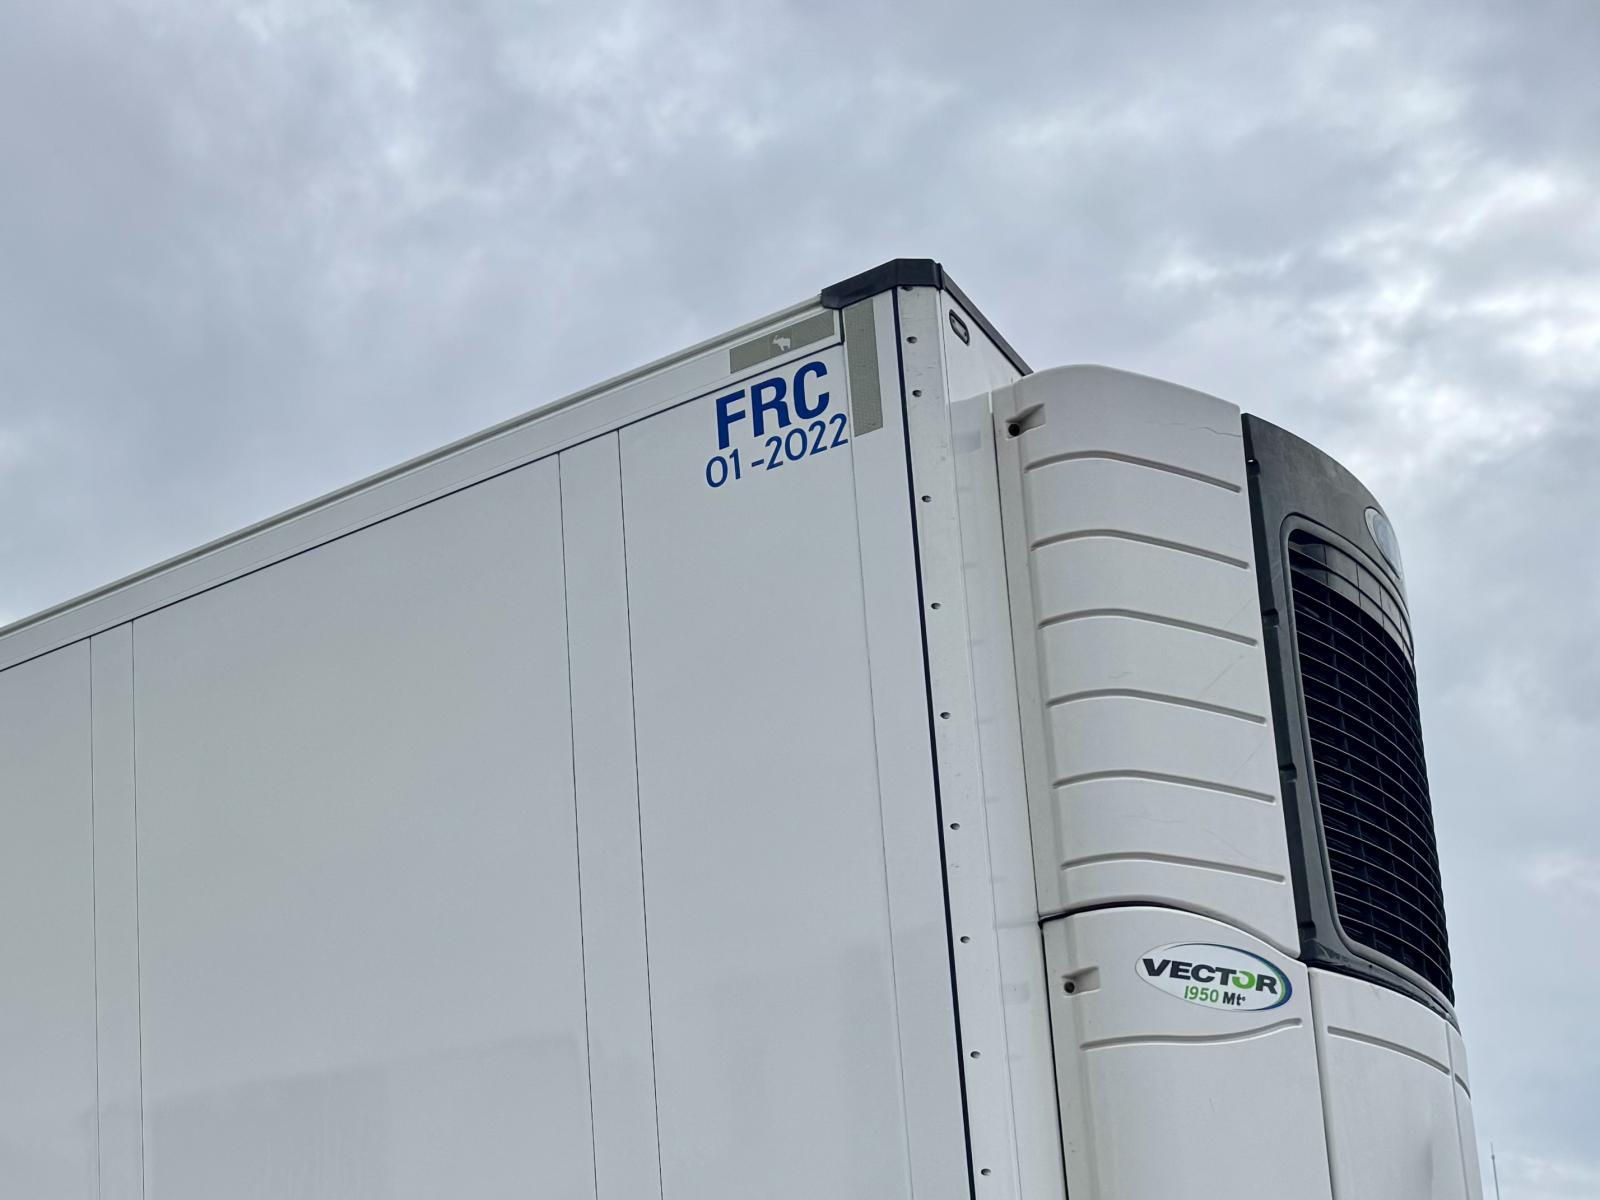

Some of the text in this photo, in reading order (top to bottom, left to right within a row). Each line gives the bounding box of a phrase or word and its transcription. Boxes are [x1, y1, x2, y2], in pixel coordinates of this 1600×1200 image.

[715, 361, 830, 450] FRC
[705, 413, 848, 488] 01-2022
[1142, 958, 1278, 995] VECTOR
[1184, 985, 1219, 1004] 1950
